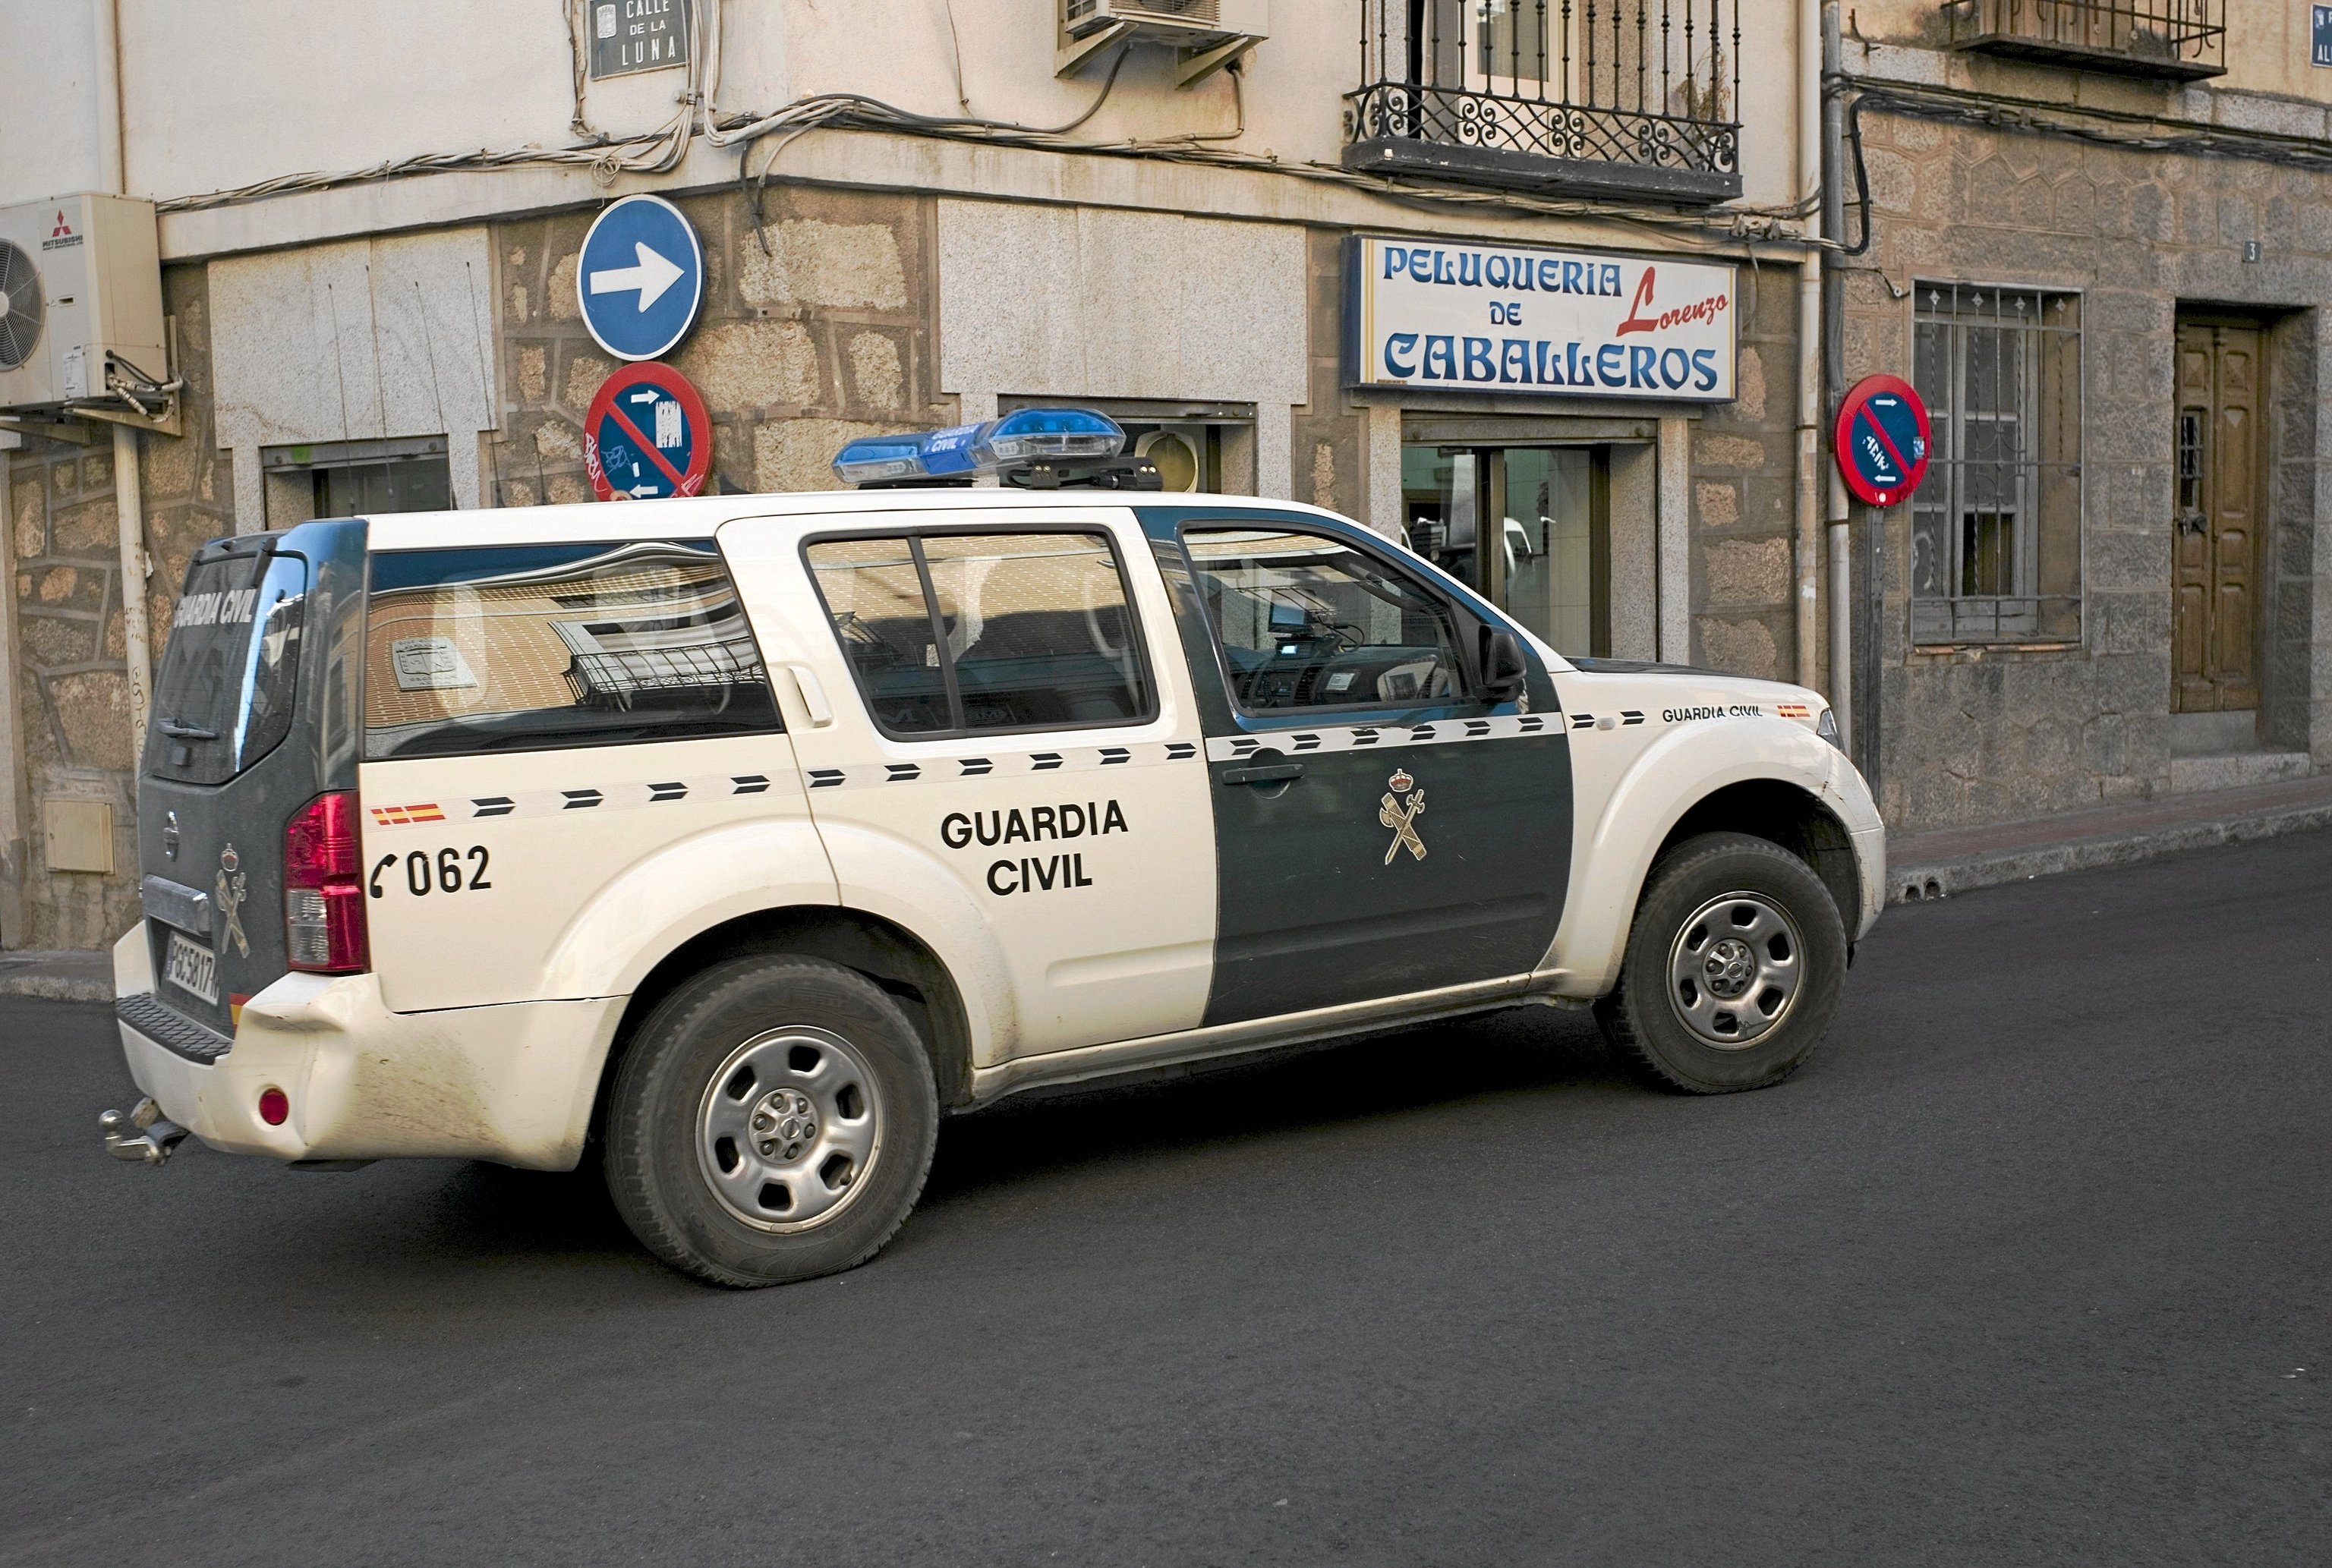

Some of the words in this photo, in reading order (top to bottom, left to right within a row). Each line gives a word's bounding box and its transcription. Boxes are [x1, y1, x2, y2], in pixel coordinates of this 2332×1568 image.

[626, 0, 670, 19] CALLE
[629, 24, 645, 36] DE
[651, 20, 667, 32] LA
[622, 36, 676, 66] LUNA
[2318, 44, 2332, 62] AL
[43, 235, 83, 247] MITSUBISHI
[2249, 242, 2255, 260] 3
[1489, 301, 1521, 326] DE
[1616, 266, 1729, 337] Lorenzo
[1384, 332, 1717, 392] CABALLEROS
[219, 589, 257, 624] CIVIL
[1662, 706, 1726, 722] GUARDIA
[1729, 706, 1763, 716] CIVIL
[941, 799, 1129, 849] GUARDIA
[407, 845, 492, 896] 062
[987, 853, 1092, 896] CIVIL
